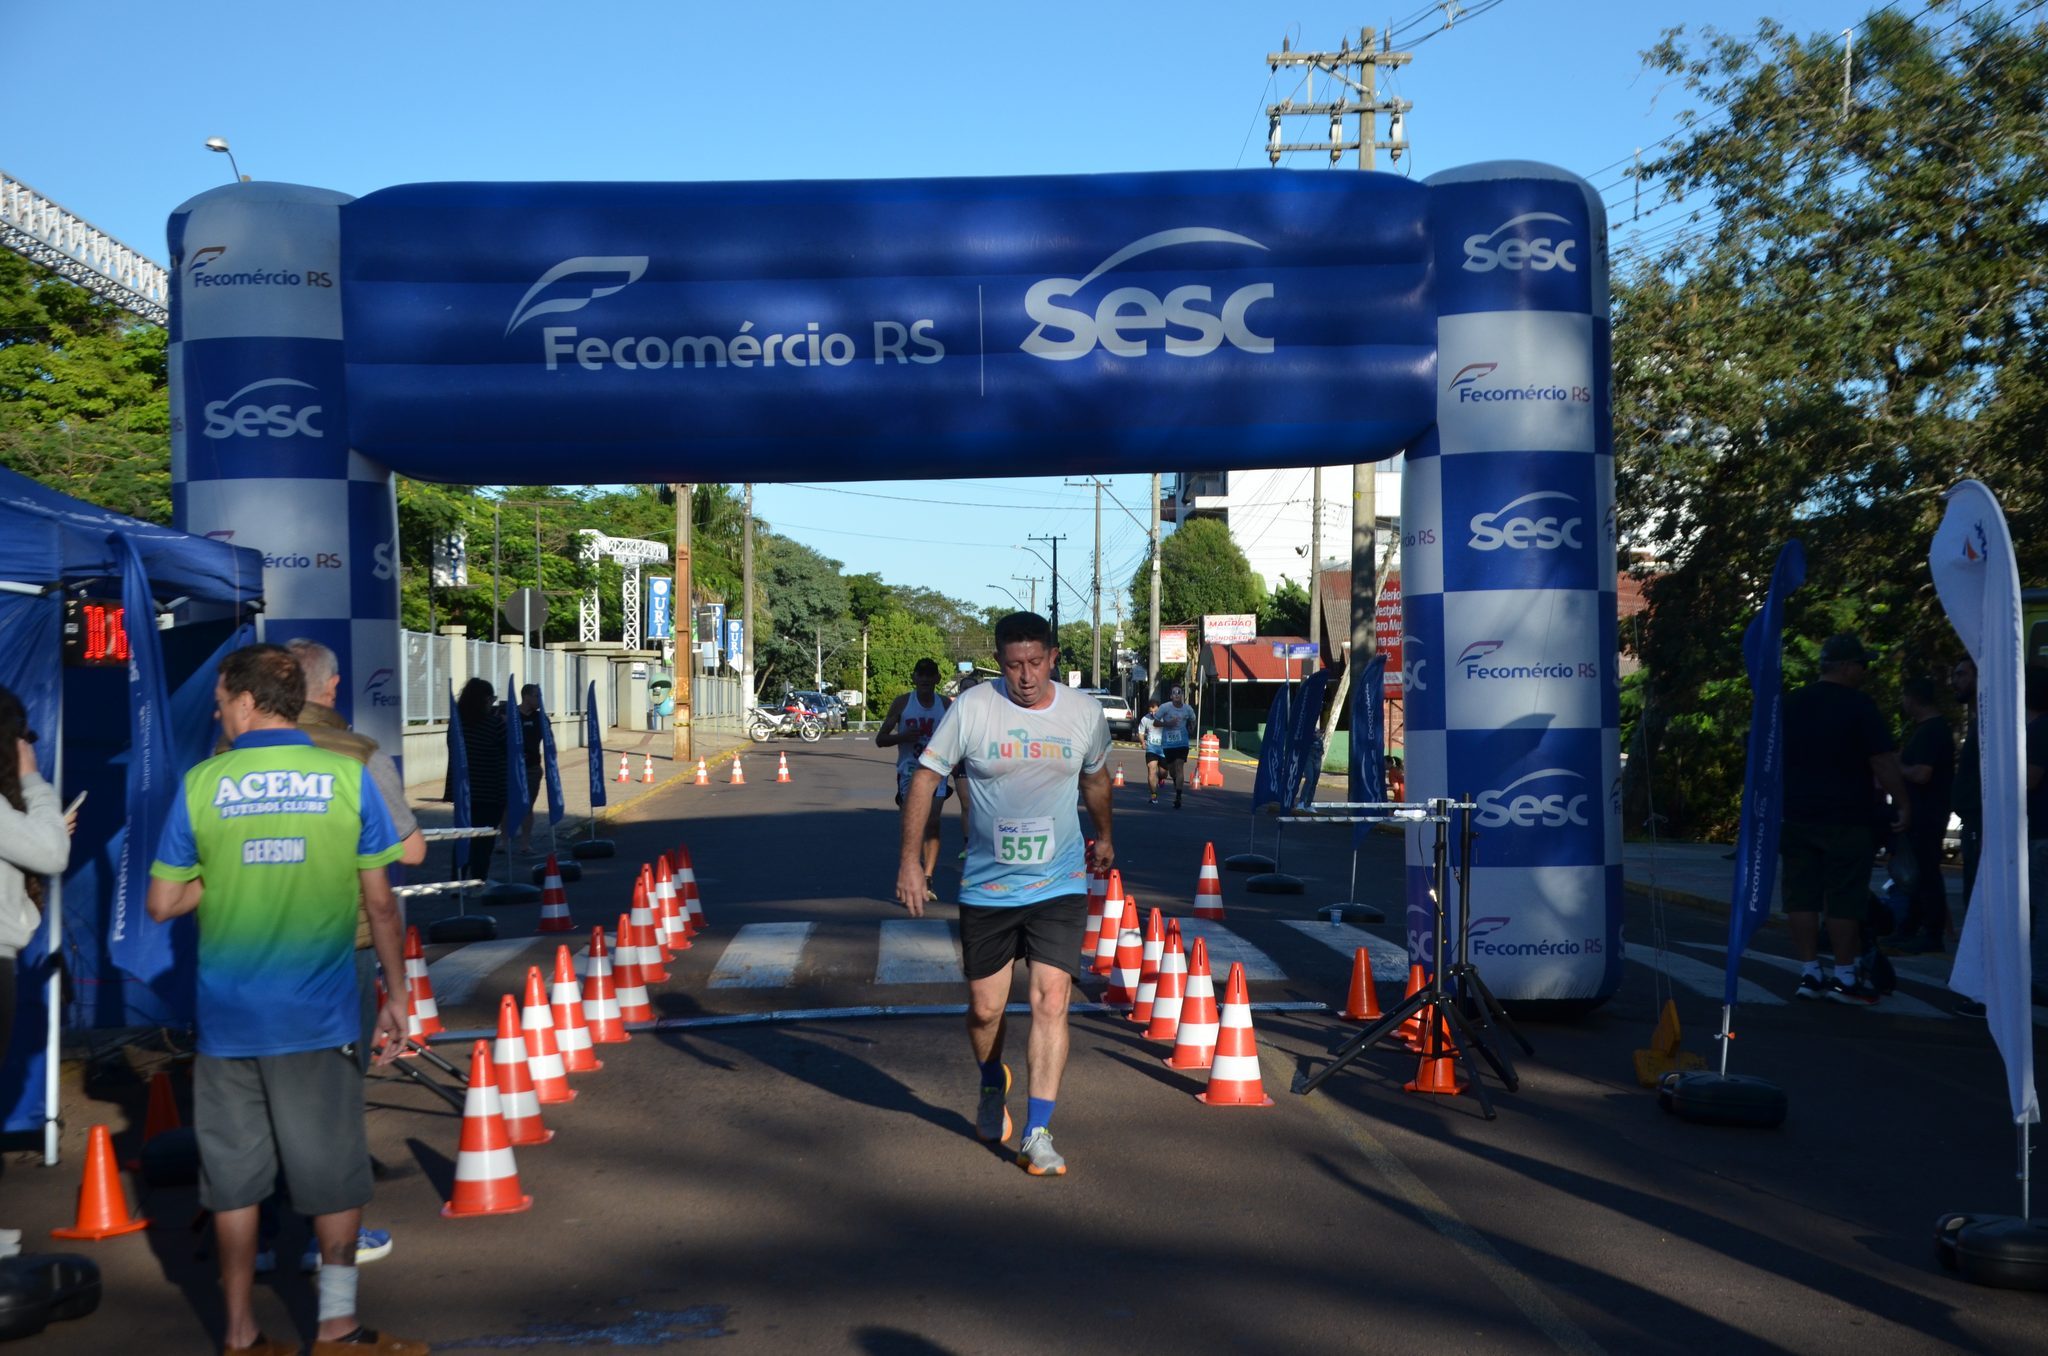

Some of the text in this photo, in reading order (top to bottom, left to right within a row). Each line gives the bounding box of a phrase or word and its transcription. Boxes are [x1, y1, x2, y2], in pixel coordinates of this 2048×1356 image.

[1461, 211, 1577, 273] Sesc
[194, 268, 333, 288] Fecomércio RS
[542, 226, 1276, 371] Fecomércio RS Sesc
[202, 377, 324, 439] Sesc
[1460, 384, 1591, 403] Fecomércio RS
[1467, 490, 1583, 551] Sesc
[1418, 528, 1436, 546] RS
[262, 552, 342, 569] ércio RS
[653, 597, 666, 637] URI
[1404, 658, 1427, 692] sc
[1466, 662, 1597, 680] Fecomércio RS
[987, 741, 1073, 760] Autismo
[213, 769, 335, 806] ACEMI
[1473, 767, 1589, 828] Sesc
[222, 800, 327, 818] FUTEBOL CLUBE
[243, 837, 306, 864] GERSON
[1001, 834, 1048, 861] 557
[1749, 822, 1766, 912] Fecomércio
[1407, 929, 1433, 962] sc
[1473, 937, 1602, 956] Fecomércio RS
